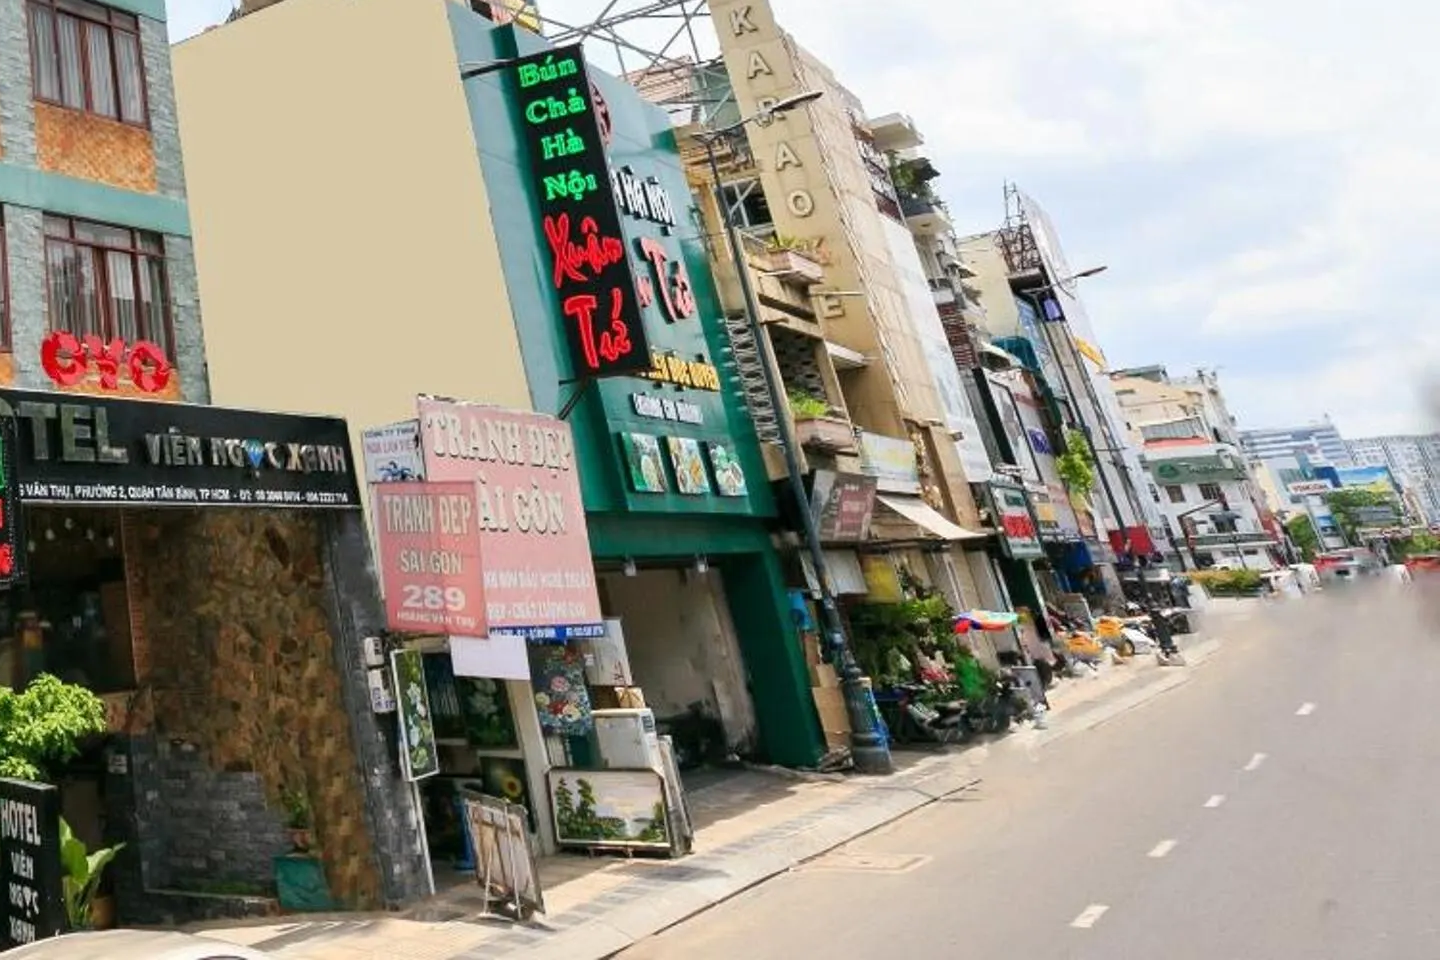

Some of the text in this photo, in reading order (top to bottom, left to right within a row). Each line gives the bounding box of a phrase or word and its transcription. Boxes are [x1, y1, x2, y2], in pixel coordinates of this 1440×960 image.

[518, 55, 577, 88] Bún
[525, 87, 587, 124] Chả
[541, 127, 586, 160] Hà
[542, 170, 597, 201] Nội
[382, 494, 435, 533] TRANH
[401, 584, 467, 612] 289
[0, 798, 42, 847] HOTEL
